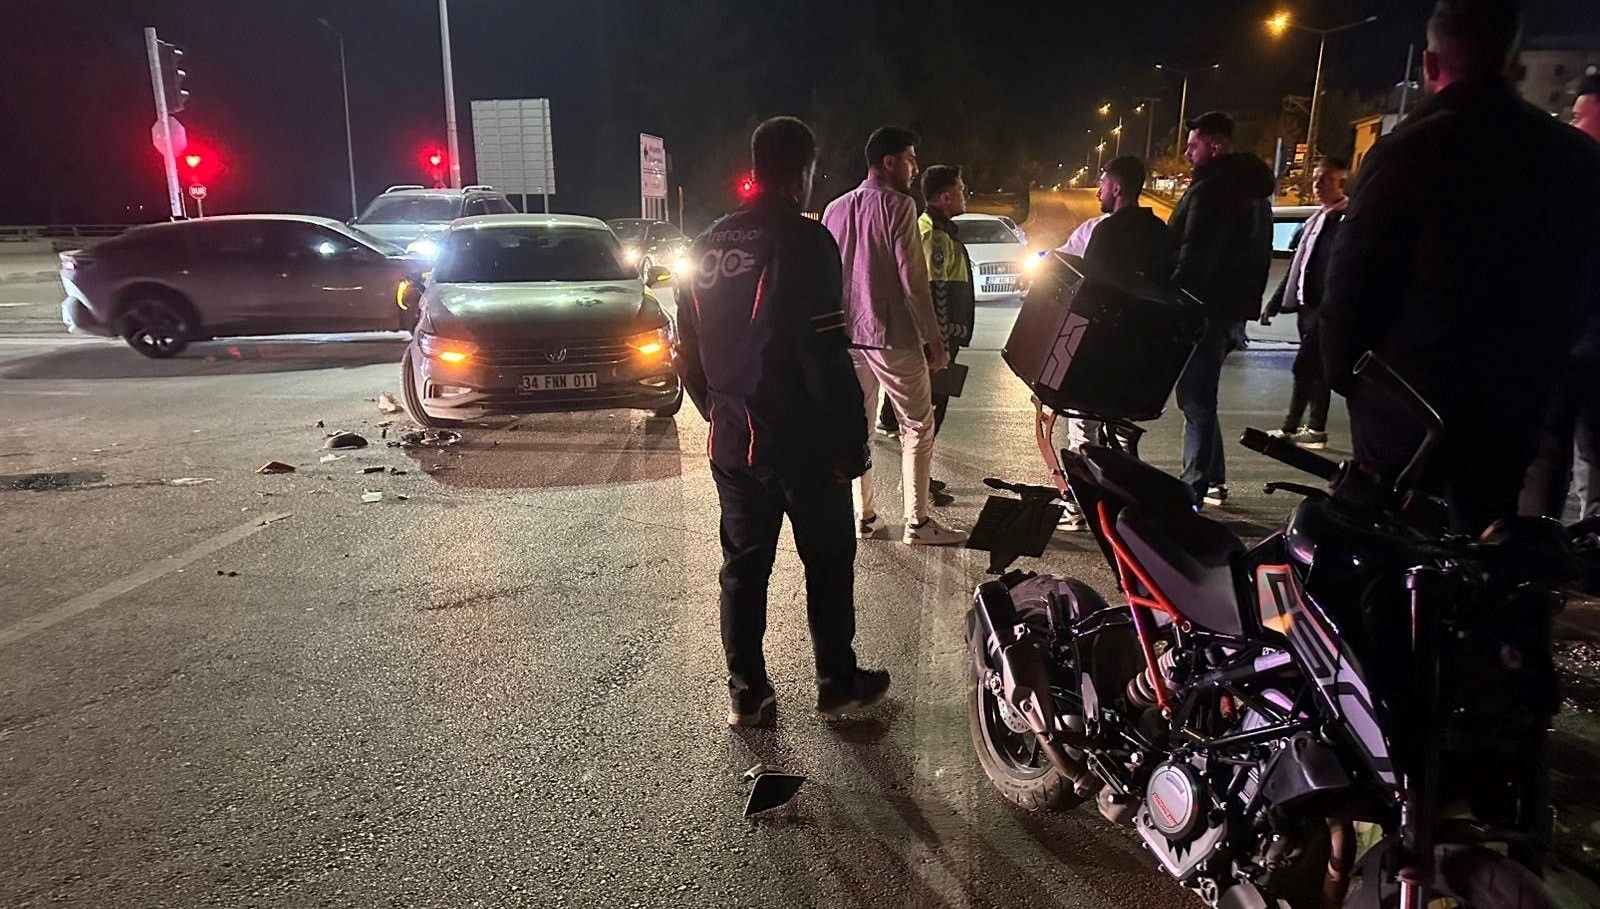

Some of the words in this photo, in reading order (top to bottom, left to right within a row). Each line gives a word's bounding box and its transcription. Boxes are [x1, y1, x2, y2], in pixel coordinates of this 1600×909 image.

[708, 227, 763, 243] trendyol
[698, 248, 753, 289] go
[523, 376, 538, 389] 34
[545, 375, 567, 388] FNN
[573, 374, 594, 387] 011
